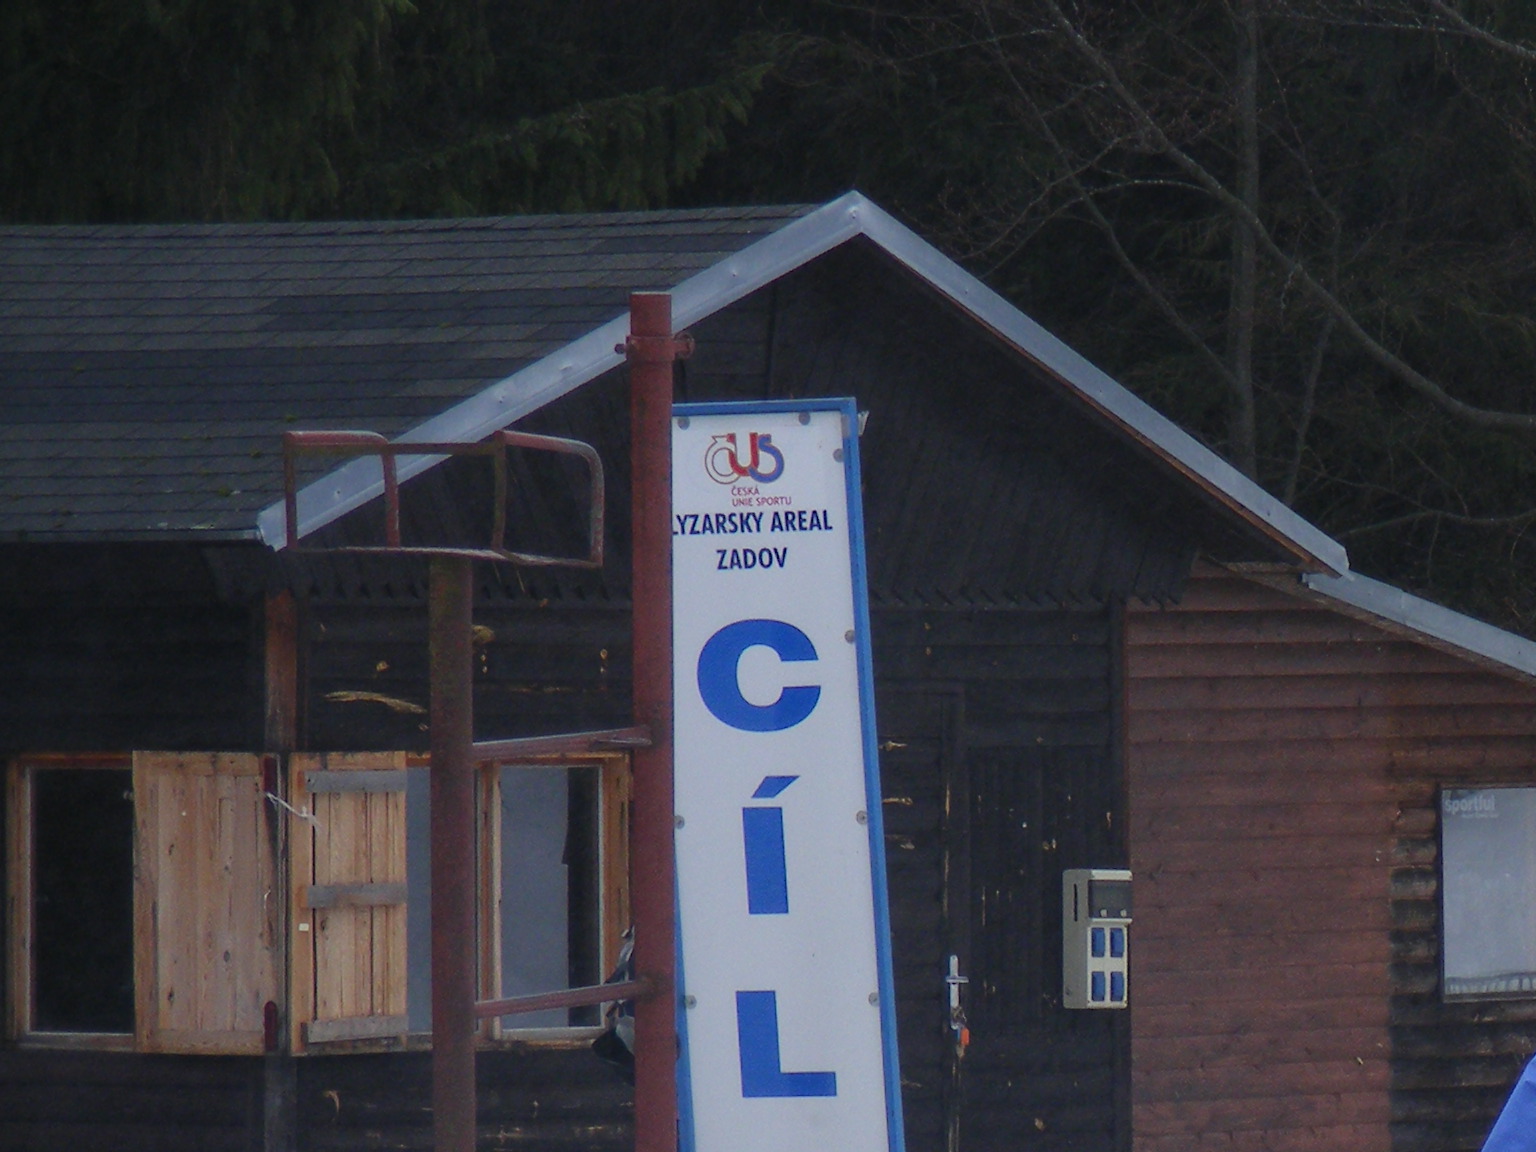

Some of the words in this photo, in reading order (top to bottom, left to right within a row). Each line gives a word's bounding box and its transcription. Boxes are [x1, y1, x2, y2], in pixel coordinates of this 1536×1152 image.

[731, 485, 760, 496] ČESKÁ
[732, 498, 753, 507] UNIE
[756, 496, 792, 506] SPORTU
[771, 509, 833, 533] AREAL
[716, 547, 788, 570] ZADOV
